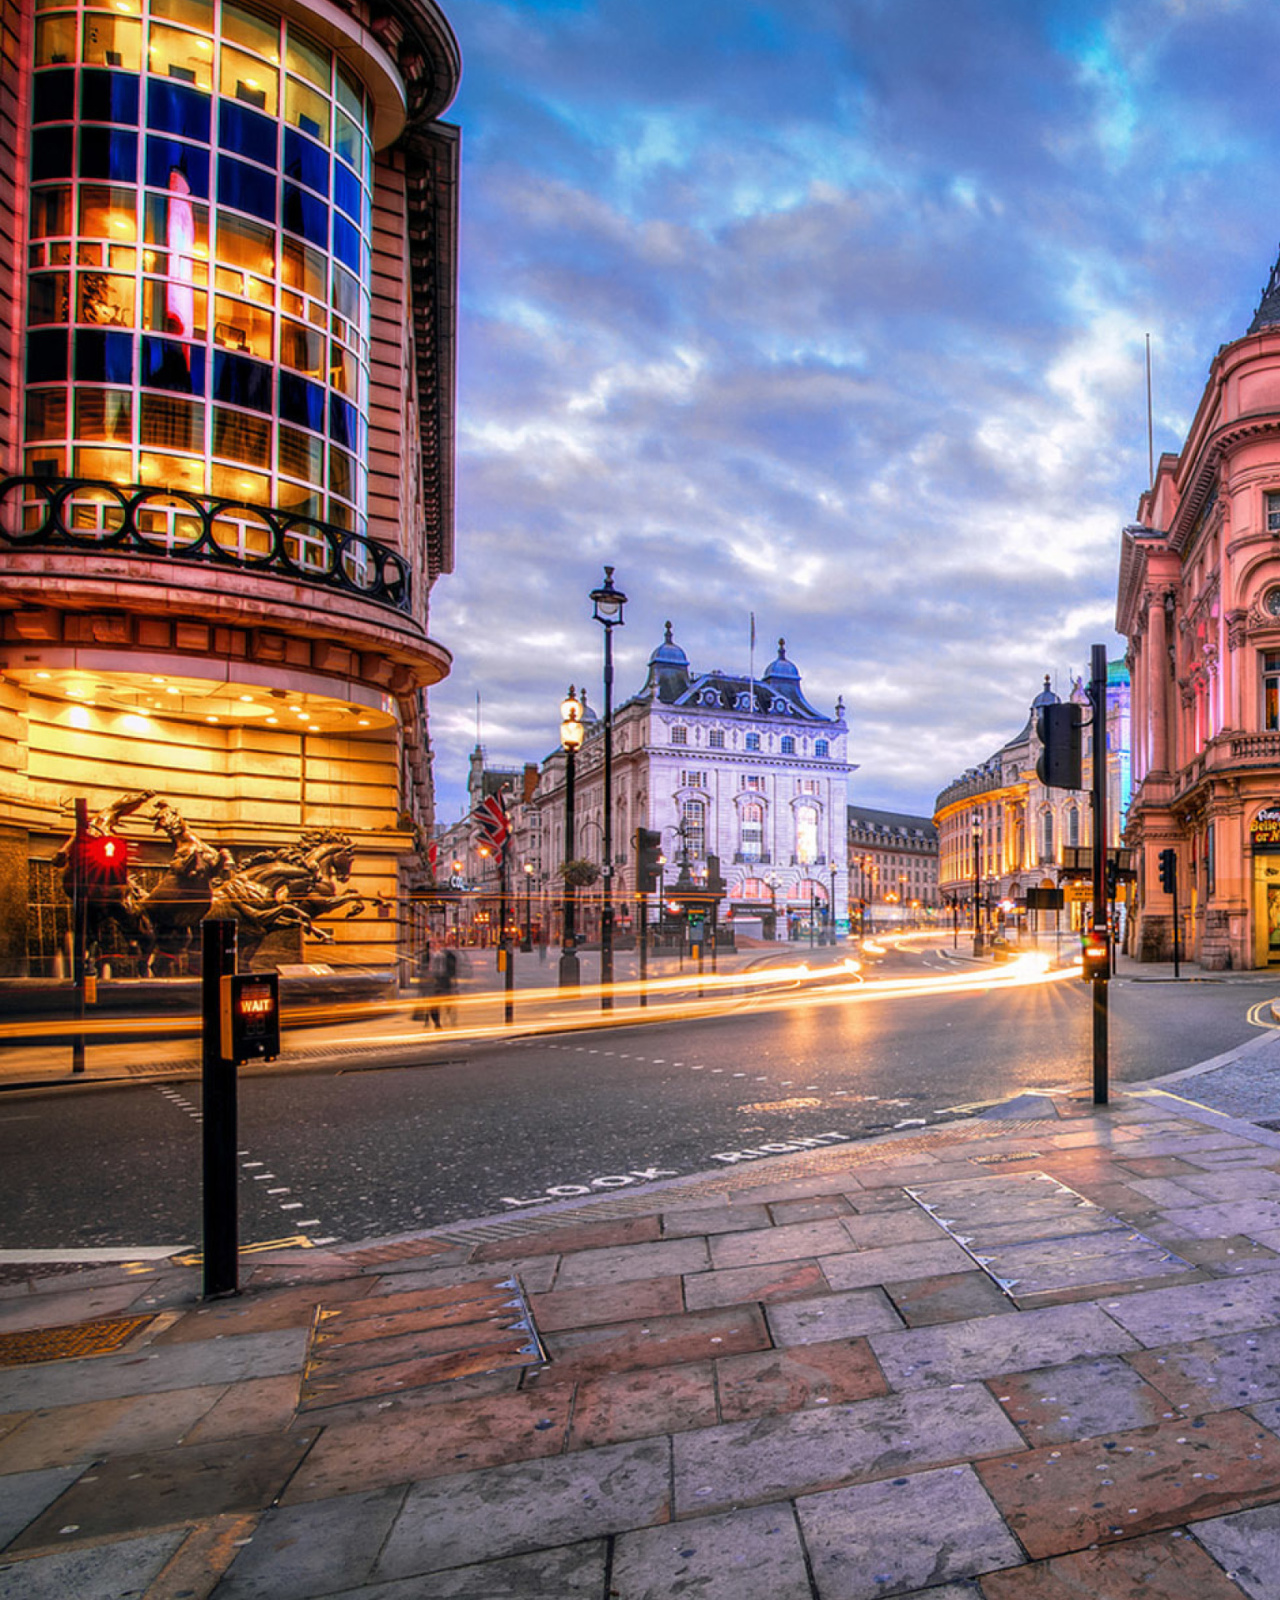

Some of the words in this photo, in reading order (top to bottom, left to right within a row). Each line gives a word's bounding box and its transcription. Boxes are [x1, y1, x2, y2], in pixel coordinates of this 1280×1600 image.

[1255, 833, 1270, 843] or
[241, 999, 270, 1013] WAIT
[500, 1167, 680, 1206] LOOK
[710, 1131, 851, 1163] RIGHT
